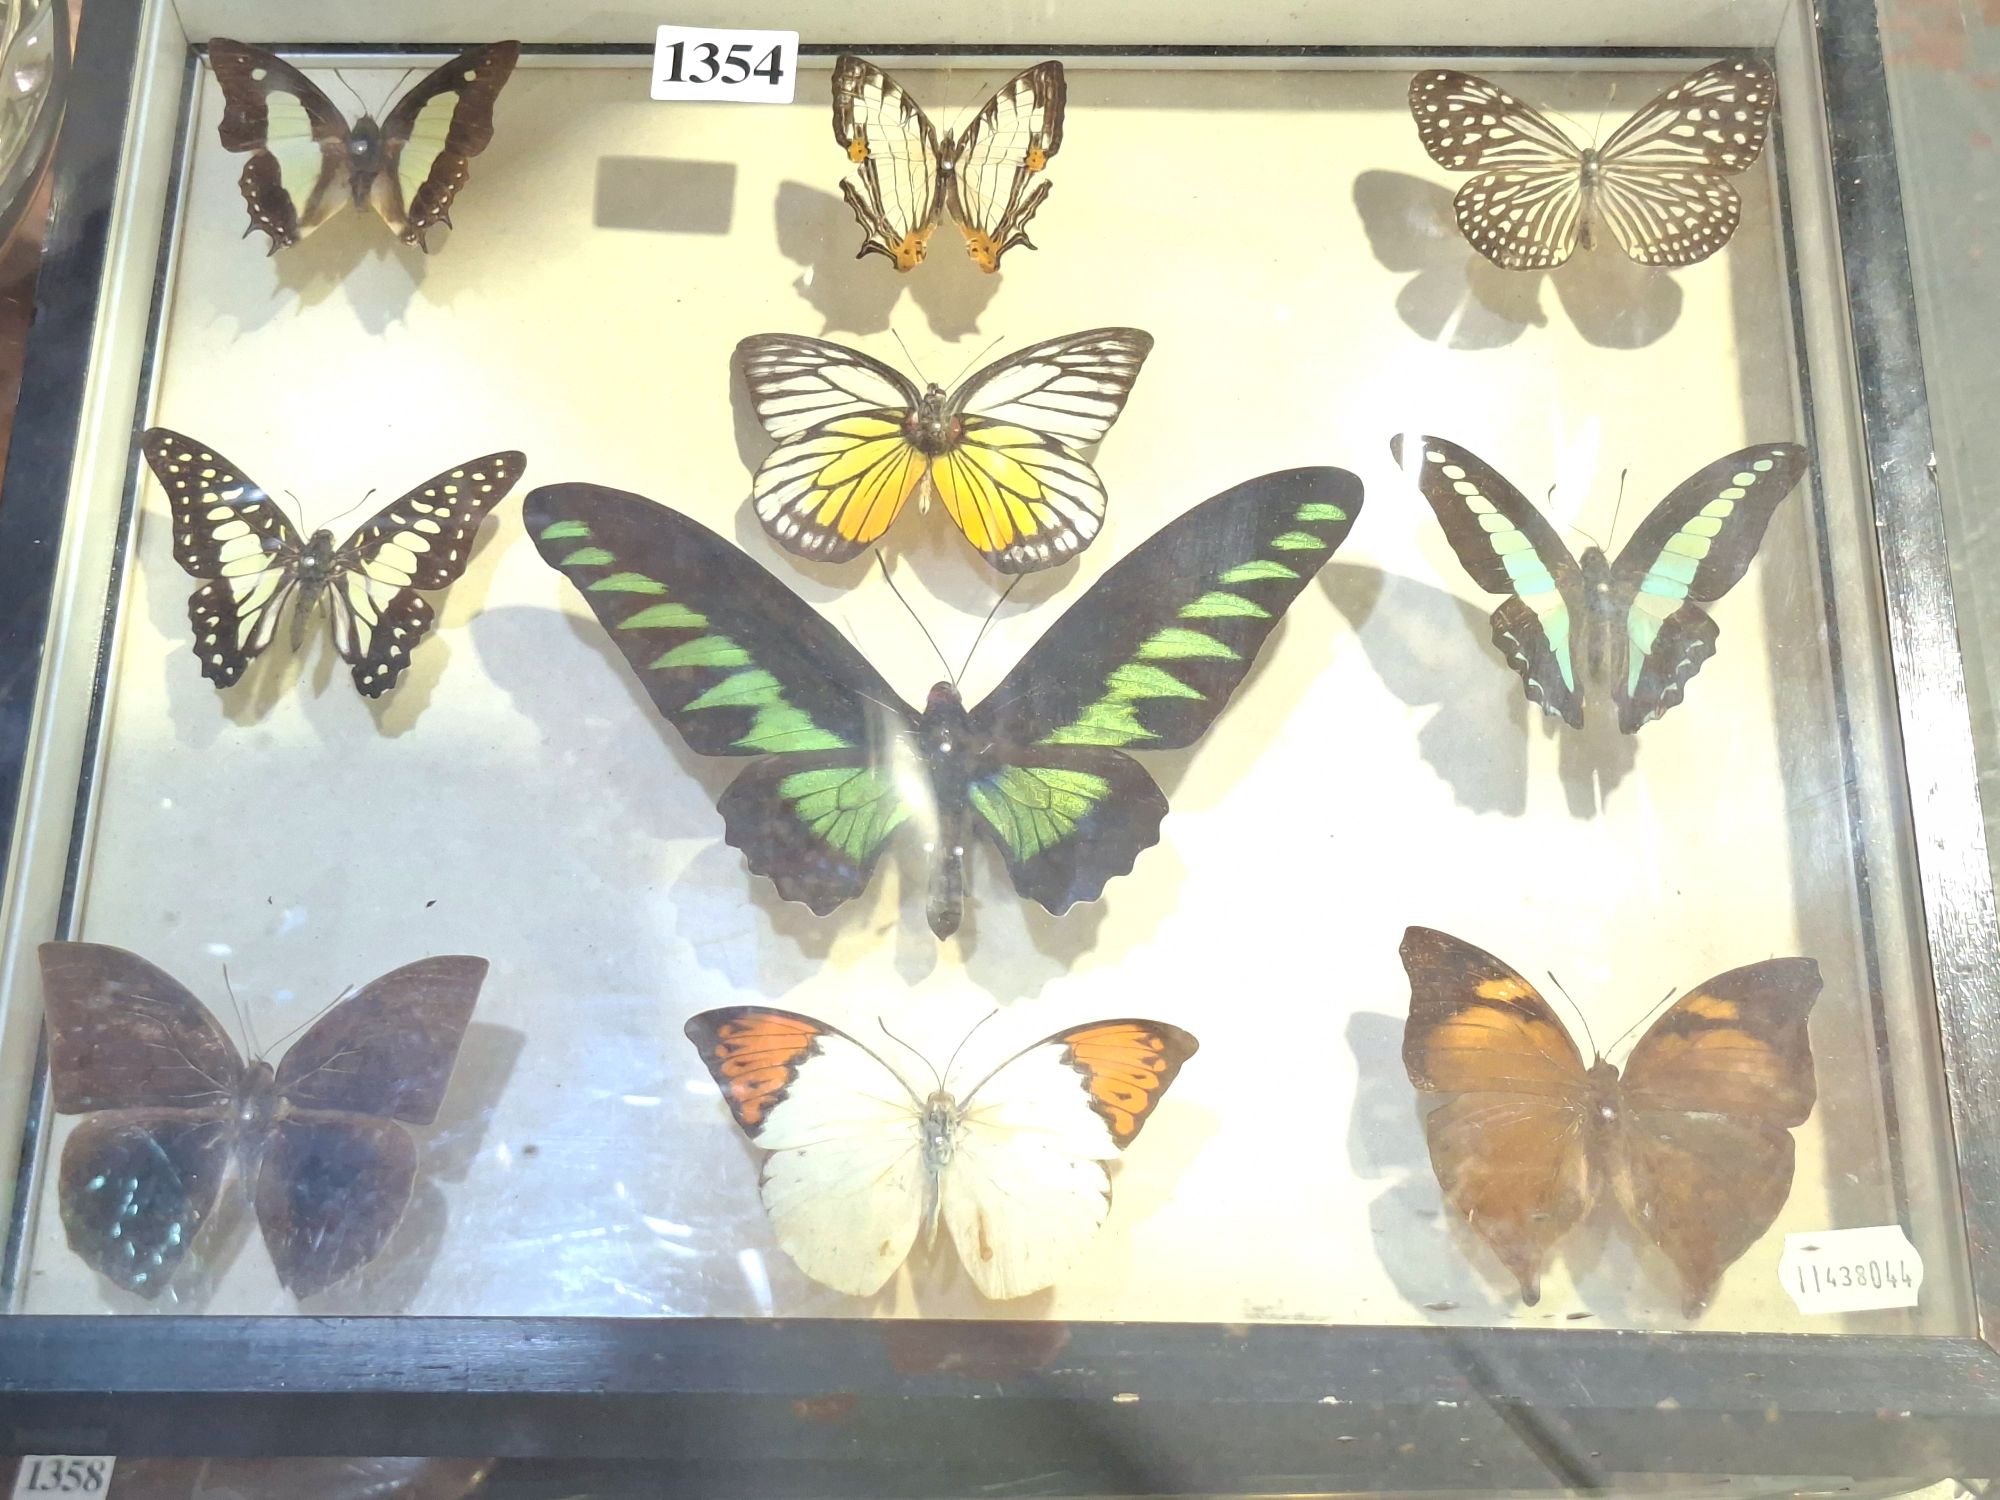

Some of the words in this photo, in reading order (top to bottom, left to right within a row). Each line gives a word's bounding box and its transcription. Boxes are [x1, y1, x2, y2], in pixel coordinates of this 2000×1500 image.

[662, 41, 784, 85] 1354
[1798, 1260, 1912, 1293] 11438044
[28, 1459, 105, 1491] 1358
